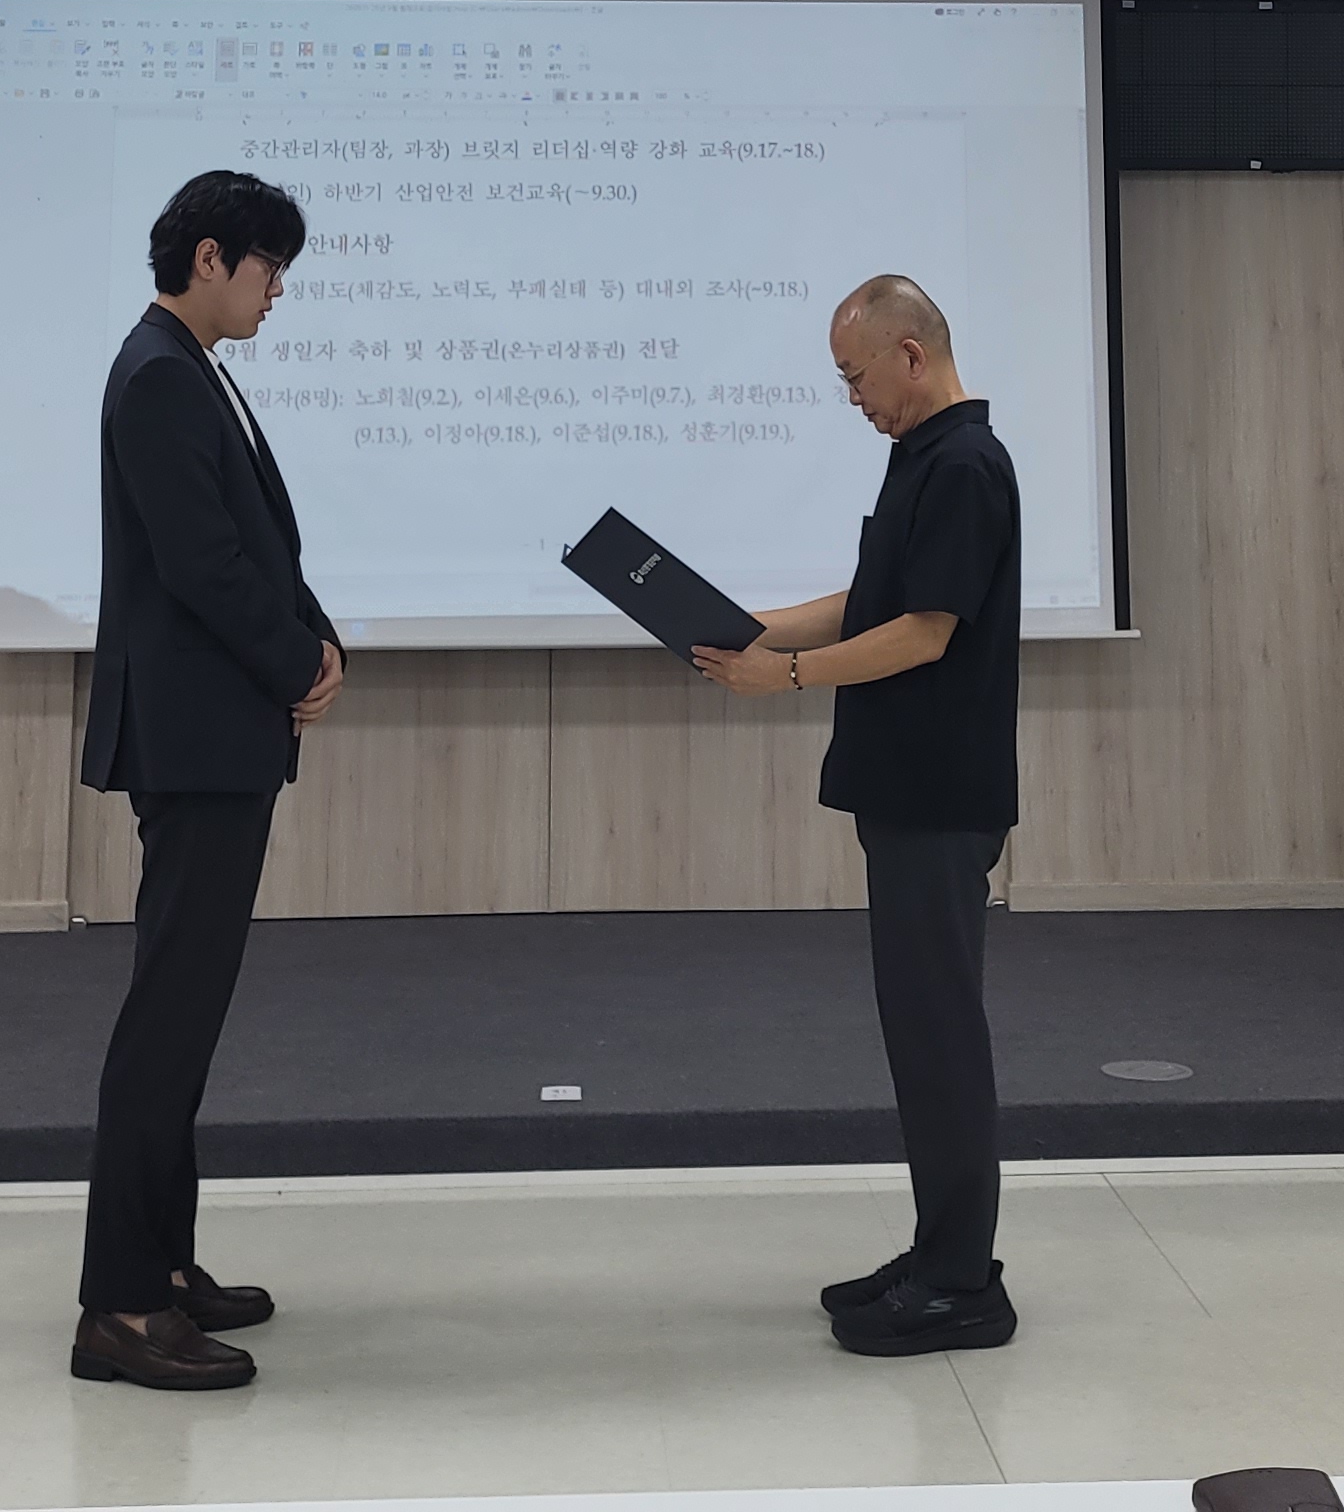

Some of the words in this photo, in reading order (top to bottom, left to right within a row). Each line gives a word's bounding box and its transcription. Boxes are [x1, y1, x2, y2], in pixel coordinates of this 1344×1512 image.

[240, 138, 393, 163] 중간관리자(팀장,
[404, 138, 450, 162] 과장)
[461, 138, 519, 159] 브릿지
[648, 139, 688, 159] 강화
[698, 140, 825, 163] 교육(9.17.~18.)
[323, 181, 382, 202] 하반기
[395, 182, 474, 202] 산업안전
[307, 233, 394, 255] 안내사항
[432, 279, 497, 301] 노력도,
[507, 278, 586, 299] 부패실태
[599, 279, 625, 302] 등)
[636, 278, 693, 299] 대내외
[226, 341, 257, 362] 9월
[271, 340, 337, 361] 생일자
[348, 340, 392, 361] 축하
[404, 340, 423, 361] 및
[638, 338, 680, 359] 전달
